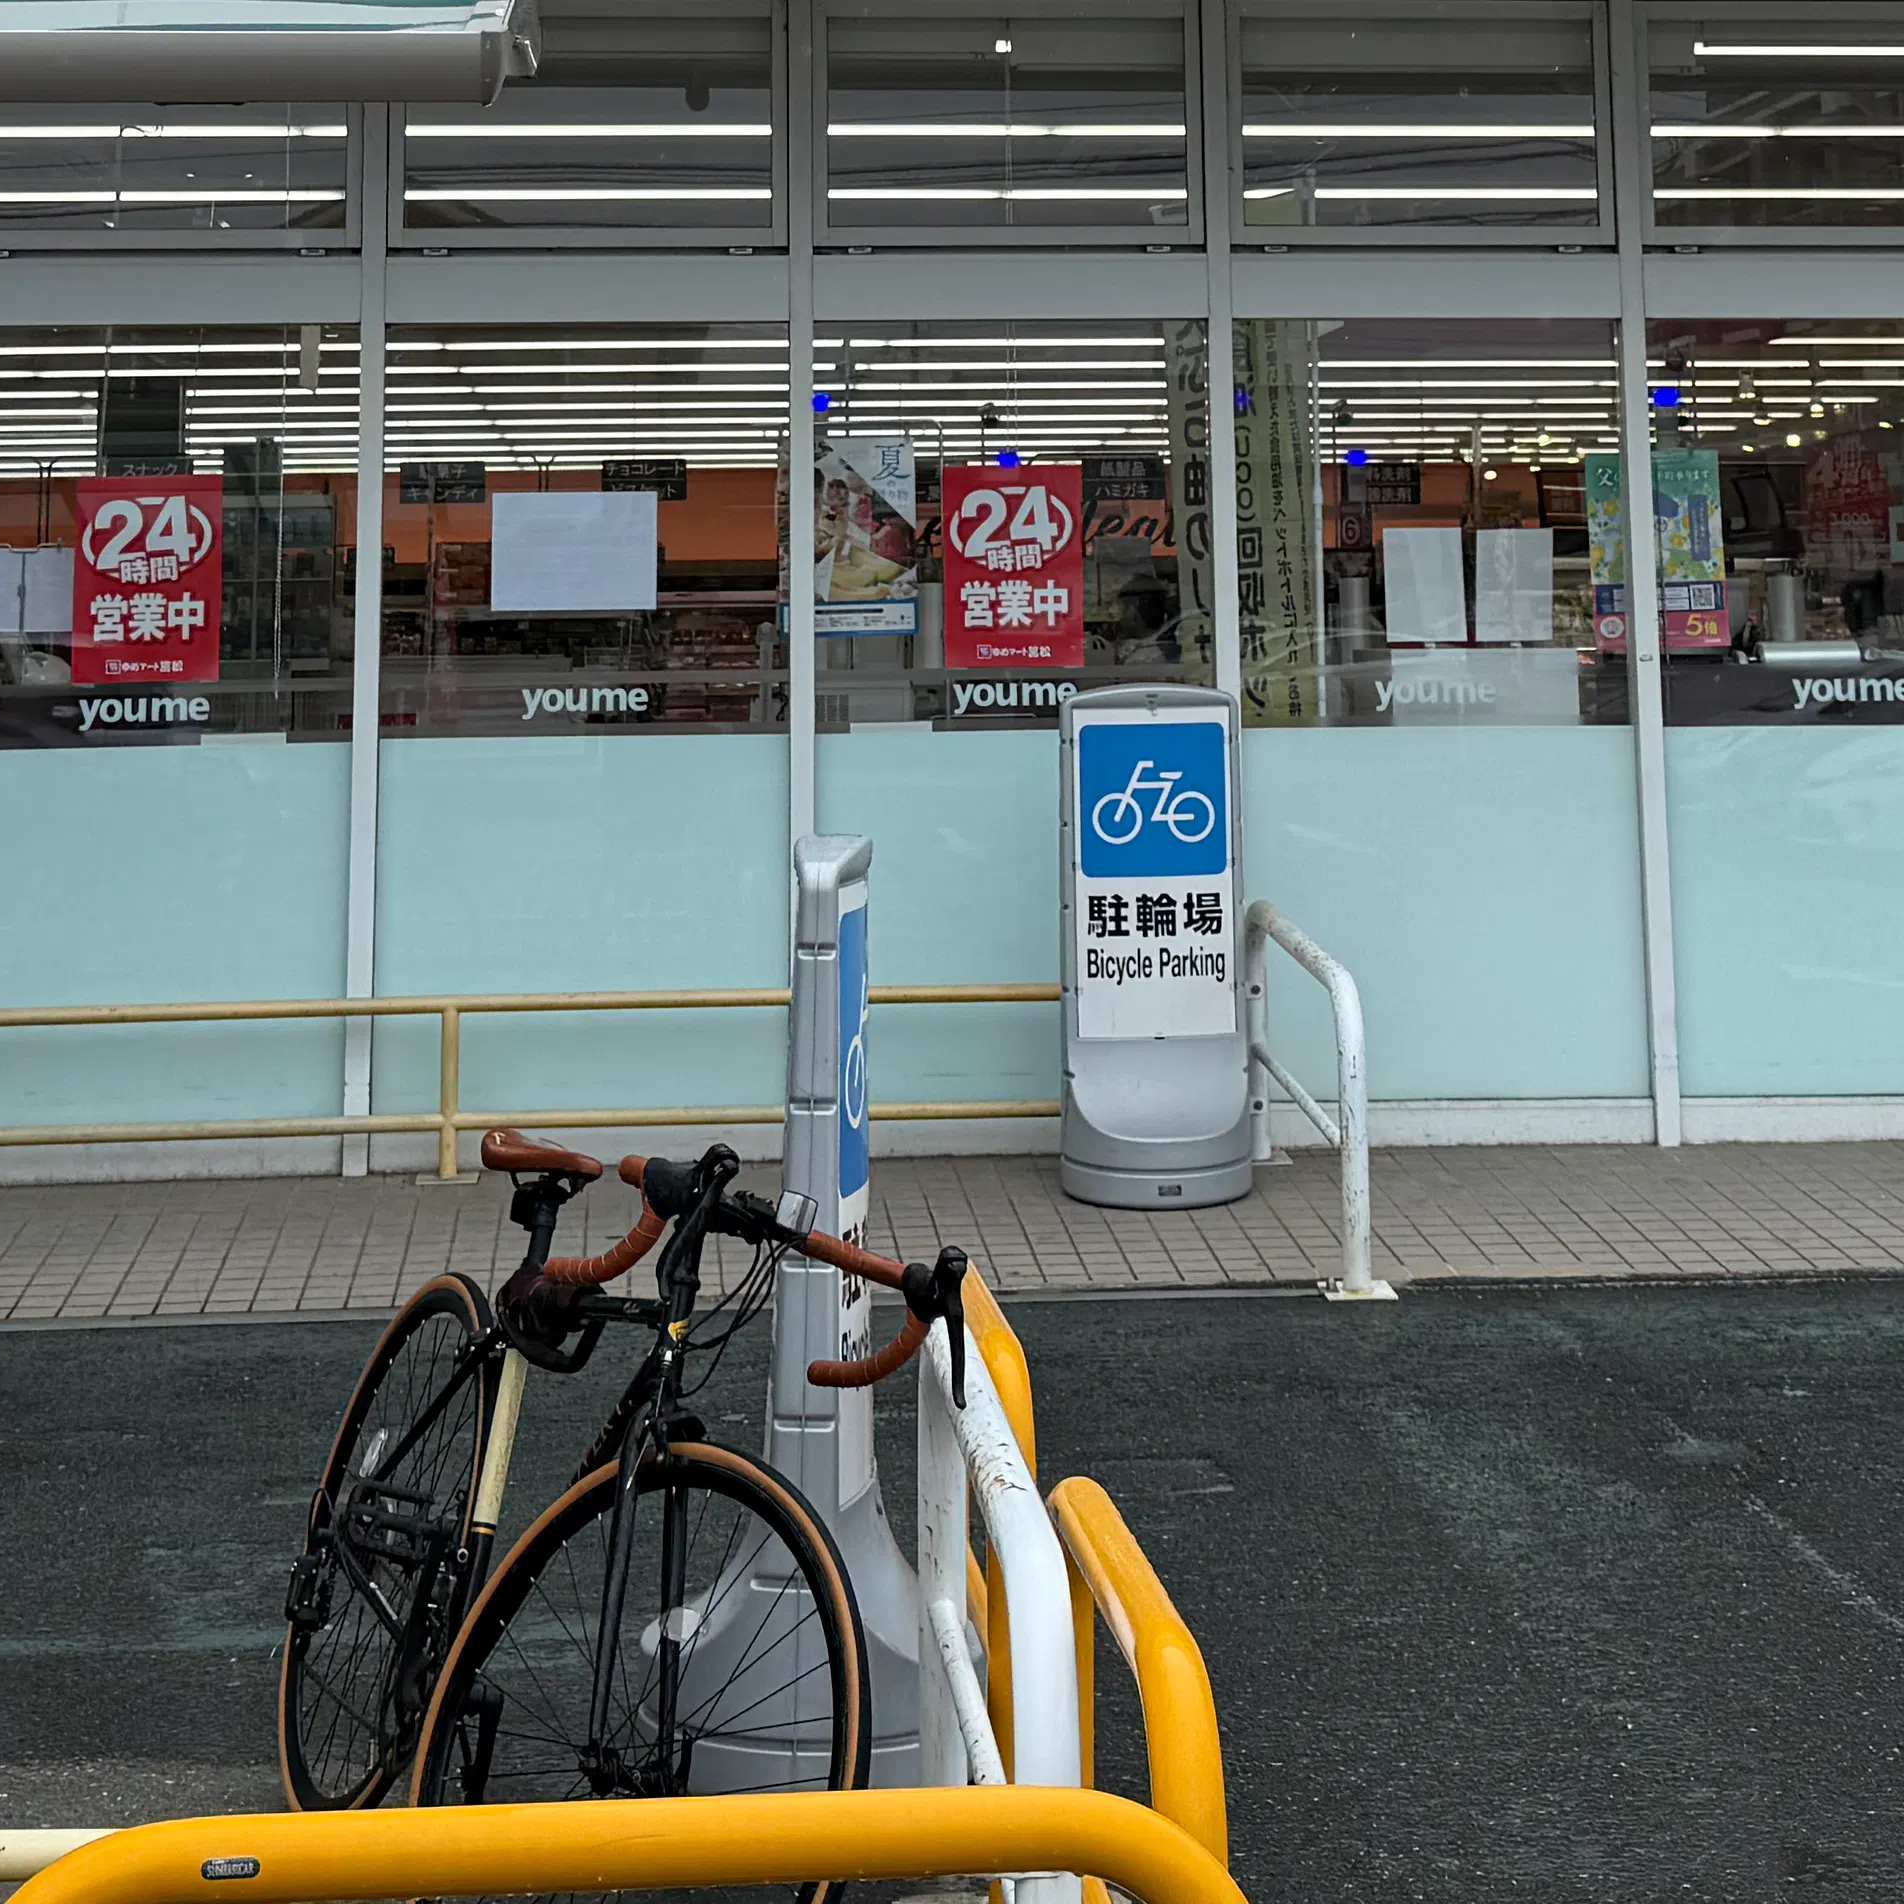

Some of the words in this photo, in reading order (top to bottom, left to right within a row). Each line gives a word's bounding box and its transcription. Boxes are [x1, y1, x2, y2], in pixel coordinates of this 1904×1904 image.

[606, 461, 684, 476] チョコレート
[872, 443, 910, 481] 夏
[94, 495, 196, 570] 24
[962, 486, 1058, 558] 24
[118, 554, 180, 585] 時間
[987, 544, 1043, 572] 時間
[89, 592, 205, 642] 営業中
[960, 579, 1068, 628] 営業中
[78, 696, 210, 732] youme
[522, 686, 649, 721] youme
[953, 680, 1079, 714] youme
[1375, 678, 1497, 713] youme
[1087, 893, 1224, 939] 駐輪場
[1086, 947, 1153, 987] Bicycle
[1159, 947, 1227, 983] Parking
